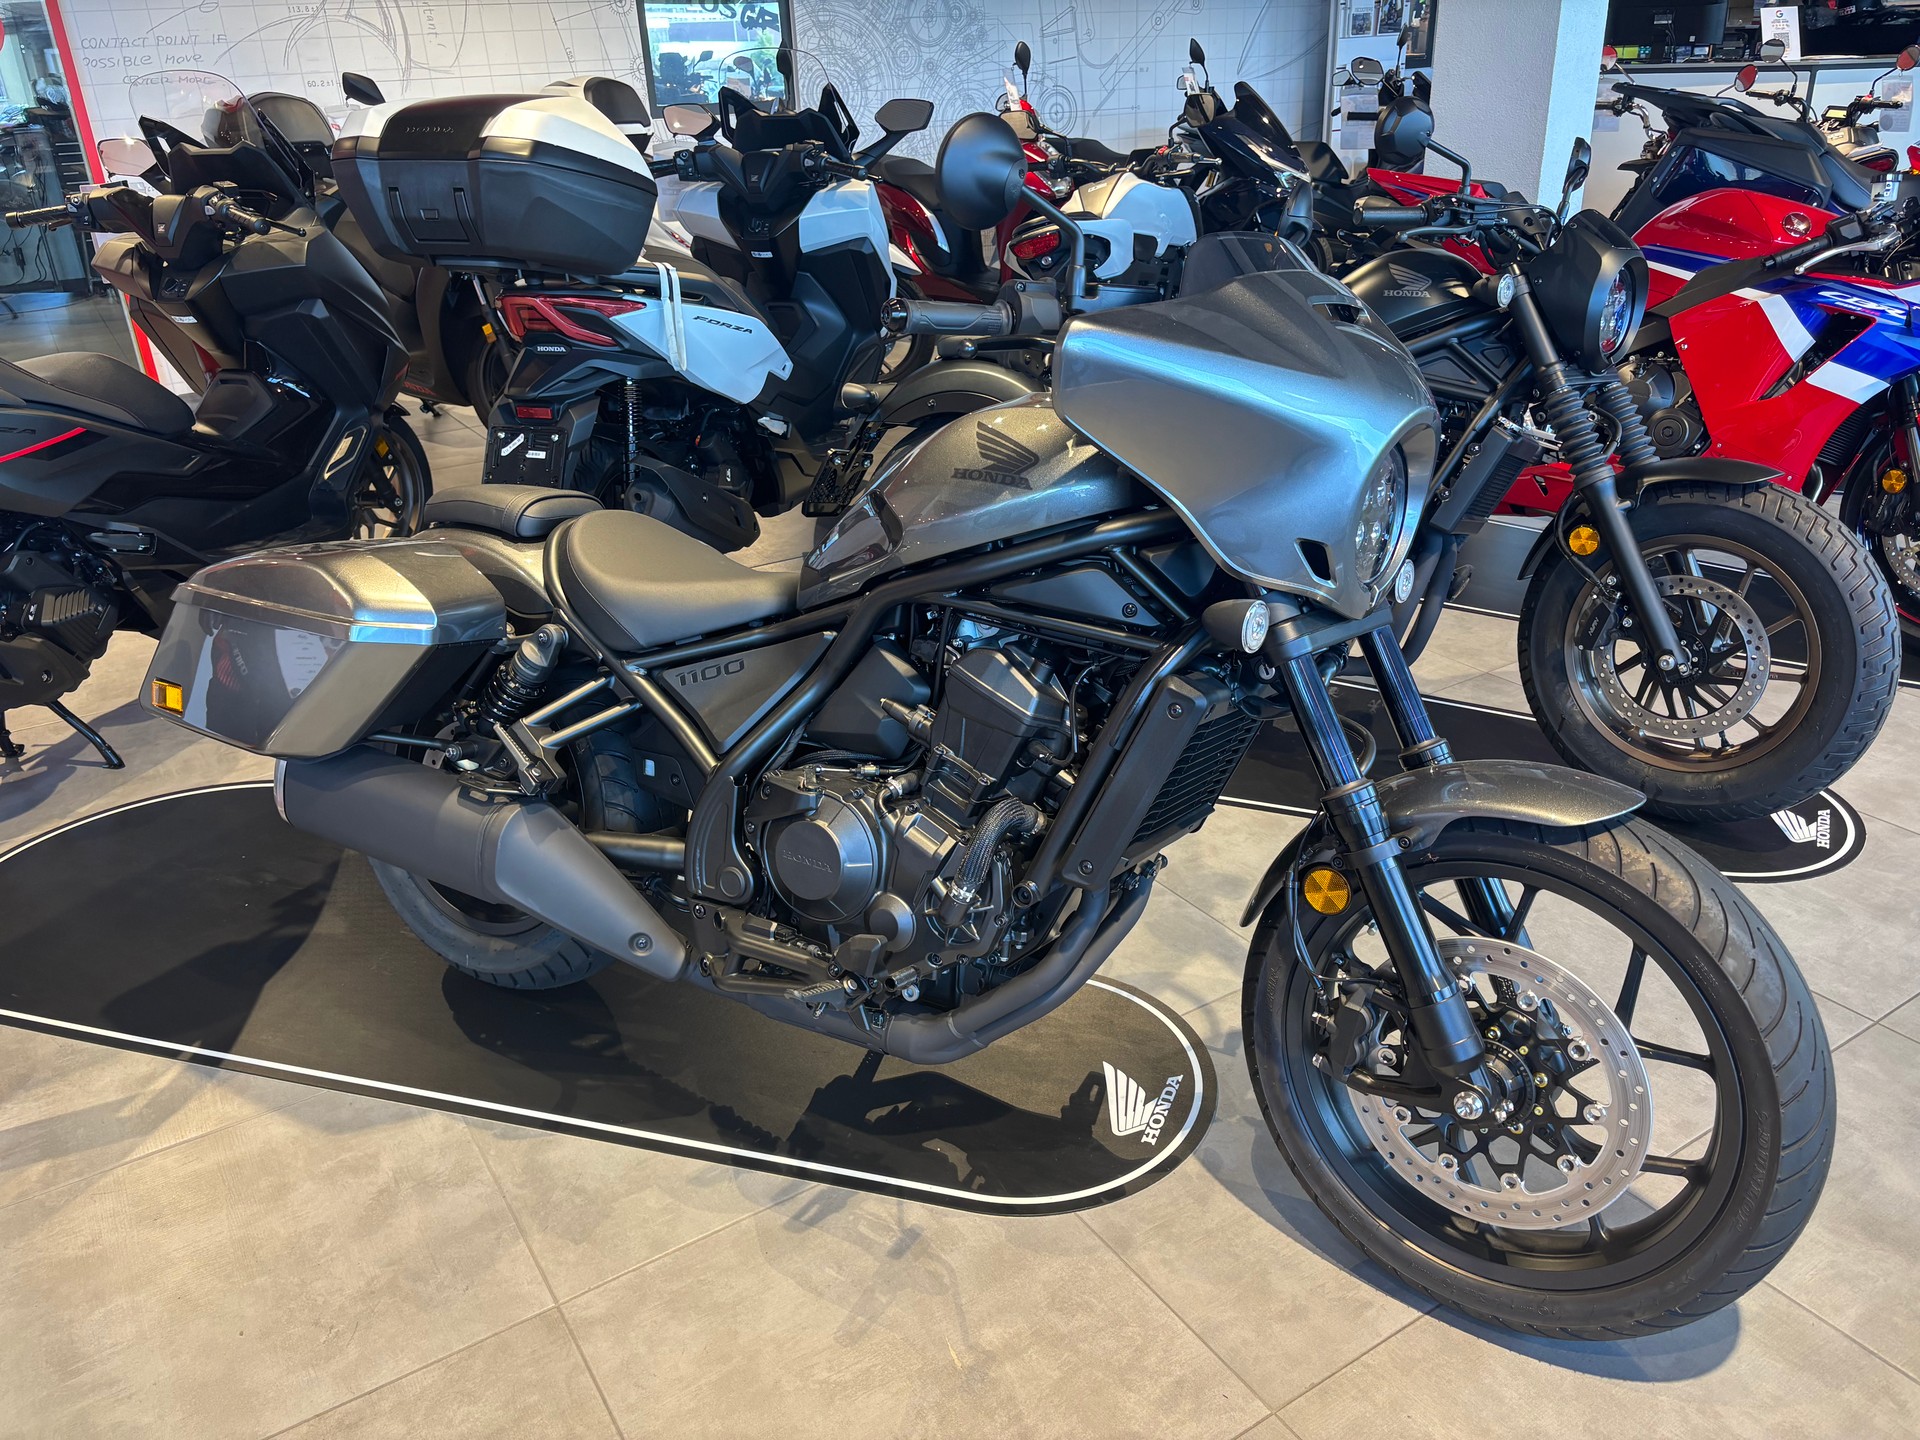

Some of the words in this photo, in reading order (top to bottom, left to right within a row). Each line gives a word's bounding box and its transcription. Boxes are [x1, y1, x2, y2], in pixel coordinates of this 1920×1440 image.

[81, 36, 149, 49] CONTACT
[156, 34, 200, 46] POINT
[212, 33, 228, 46] IF
[1383, 289, 1431, 298] HONDA
[1817, 291, 1907, 320] CBR
[693, 315, 753, 334] FORZA
[951, 467, 1033, 491] HONDA
[675, 658, 745, 687] 1100
[1816, 809, 1830, 849] HONDA
[780, 849, 833, 874] HONDA
[1141, 1074, 1183, 1146] HONDA
